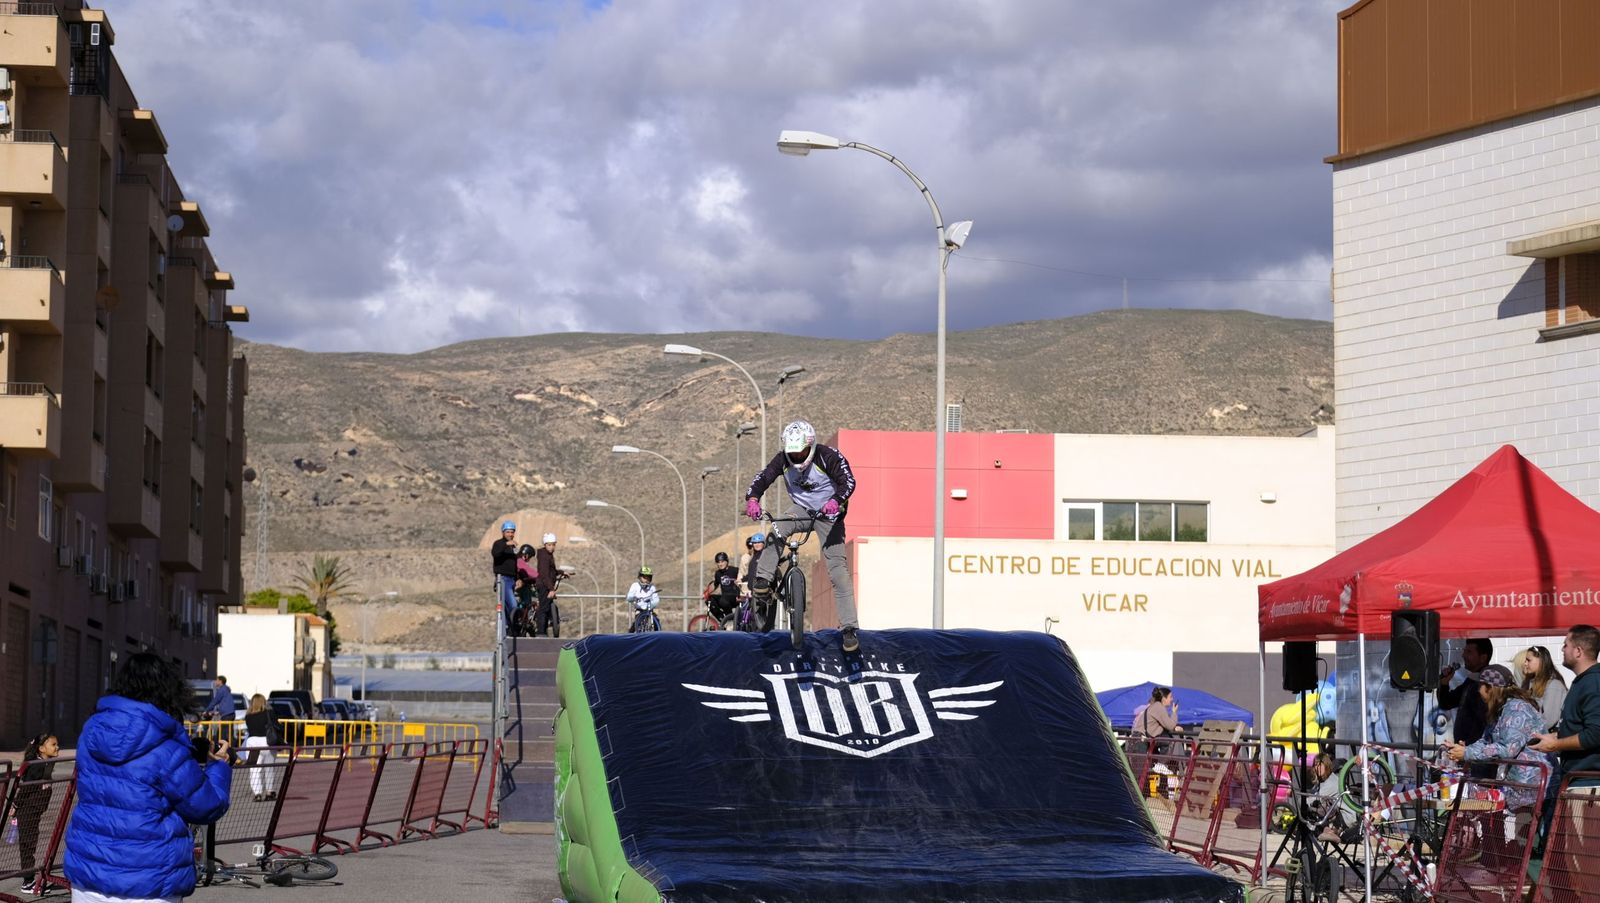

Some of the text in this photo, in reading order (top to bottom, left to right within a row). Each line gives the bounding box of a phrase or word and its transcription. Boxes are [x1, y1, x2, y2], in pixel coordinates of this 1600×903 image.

[948, 554, 1042, 575] CENTRO
[1051, 556, 1081, 575] DE
[1231, 558, 1282, 578] VIAL
